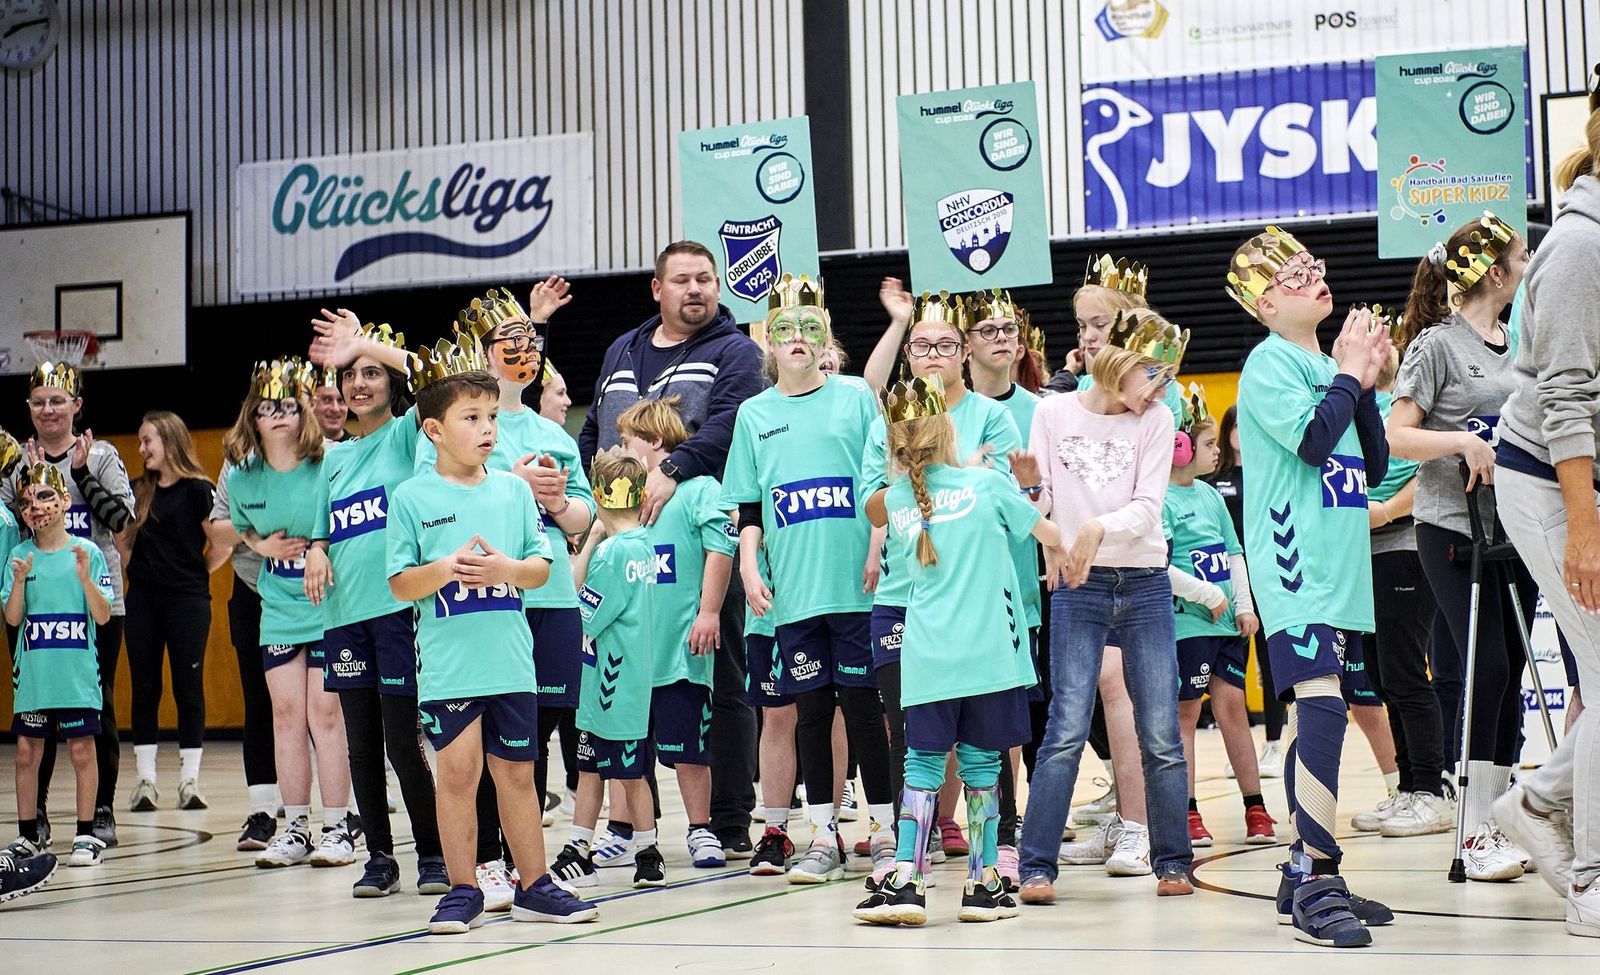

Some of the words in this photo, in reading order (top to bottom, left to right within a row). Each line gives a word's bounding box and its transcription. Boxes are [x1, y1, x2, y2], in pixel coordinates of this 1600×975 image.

[1315, 11, 1357, 31] POS
[1400, 64, 1442, 76] hummel
[1474, 91, 1496, 104] WIR
[920, 103, 961, 116] hummel
[1474, 101, 1500, 114] SIND
[993, 128, 1013, 140] WIR
[701, 138, 739, 152] hummel
[993, 137, 1017, 151] SIND
[1145, 96, 1377, 188] JYSK
[768, 161, 788, 174] WIR
[768, 170, 792, 185] SIND
[1408, 175, 1448, 186] Handball
[1451, 174, 1468, 183] Bad
[1471, 172, 1511, 183] Salzuflen
[272, 161, 553, 234] Glücksliga
[1409, 185, 1465, 205] SUPER
[1468, 184, 1509, 204] KIDZ
[946, 194, 970, 213] NHV
[942, 194, 1009, 229] CONCORDIA
[723, 217, 775, 234] EINTRACHT
[728, 241, 773, 282] OBERLÜBBE
[745, 267, 772, 292] 1925
[758, 424, 789, 441] hummel
[788, 487, 852, 514] JYSK
[421, 514, 456, 529] hummel
[1210, 551, 1231, 573] JY
[30, 621, 86, 640] JYSK
[332, 660, 367, 672] HERZSTÜCK
[838, 662, 867, 675] hummel
[381, 676, 405, 685] hummel
[500, 735, 530, 747] hummel
